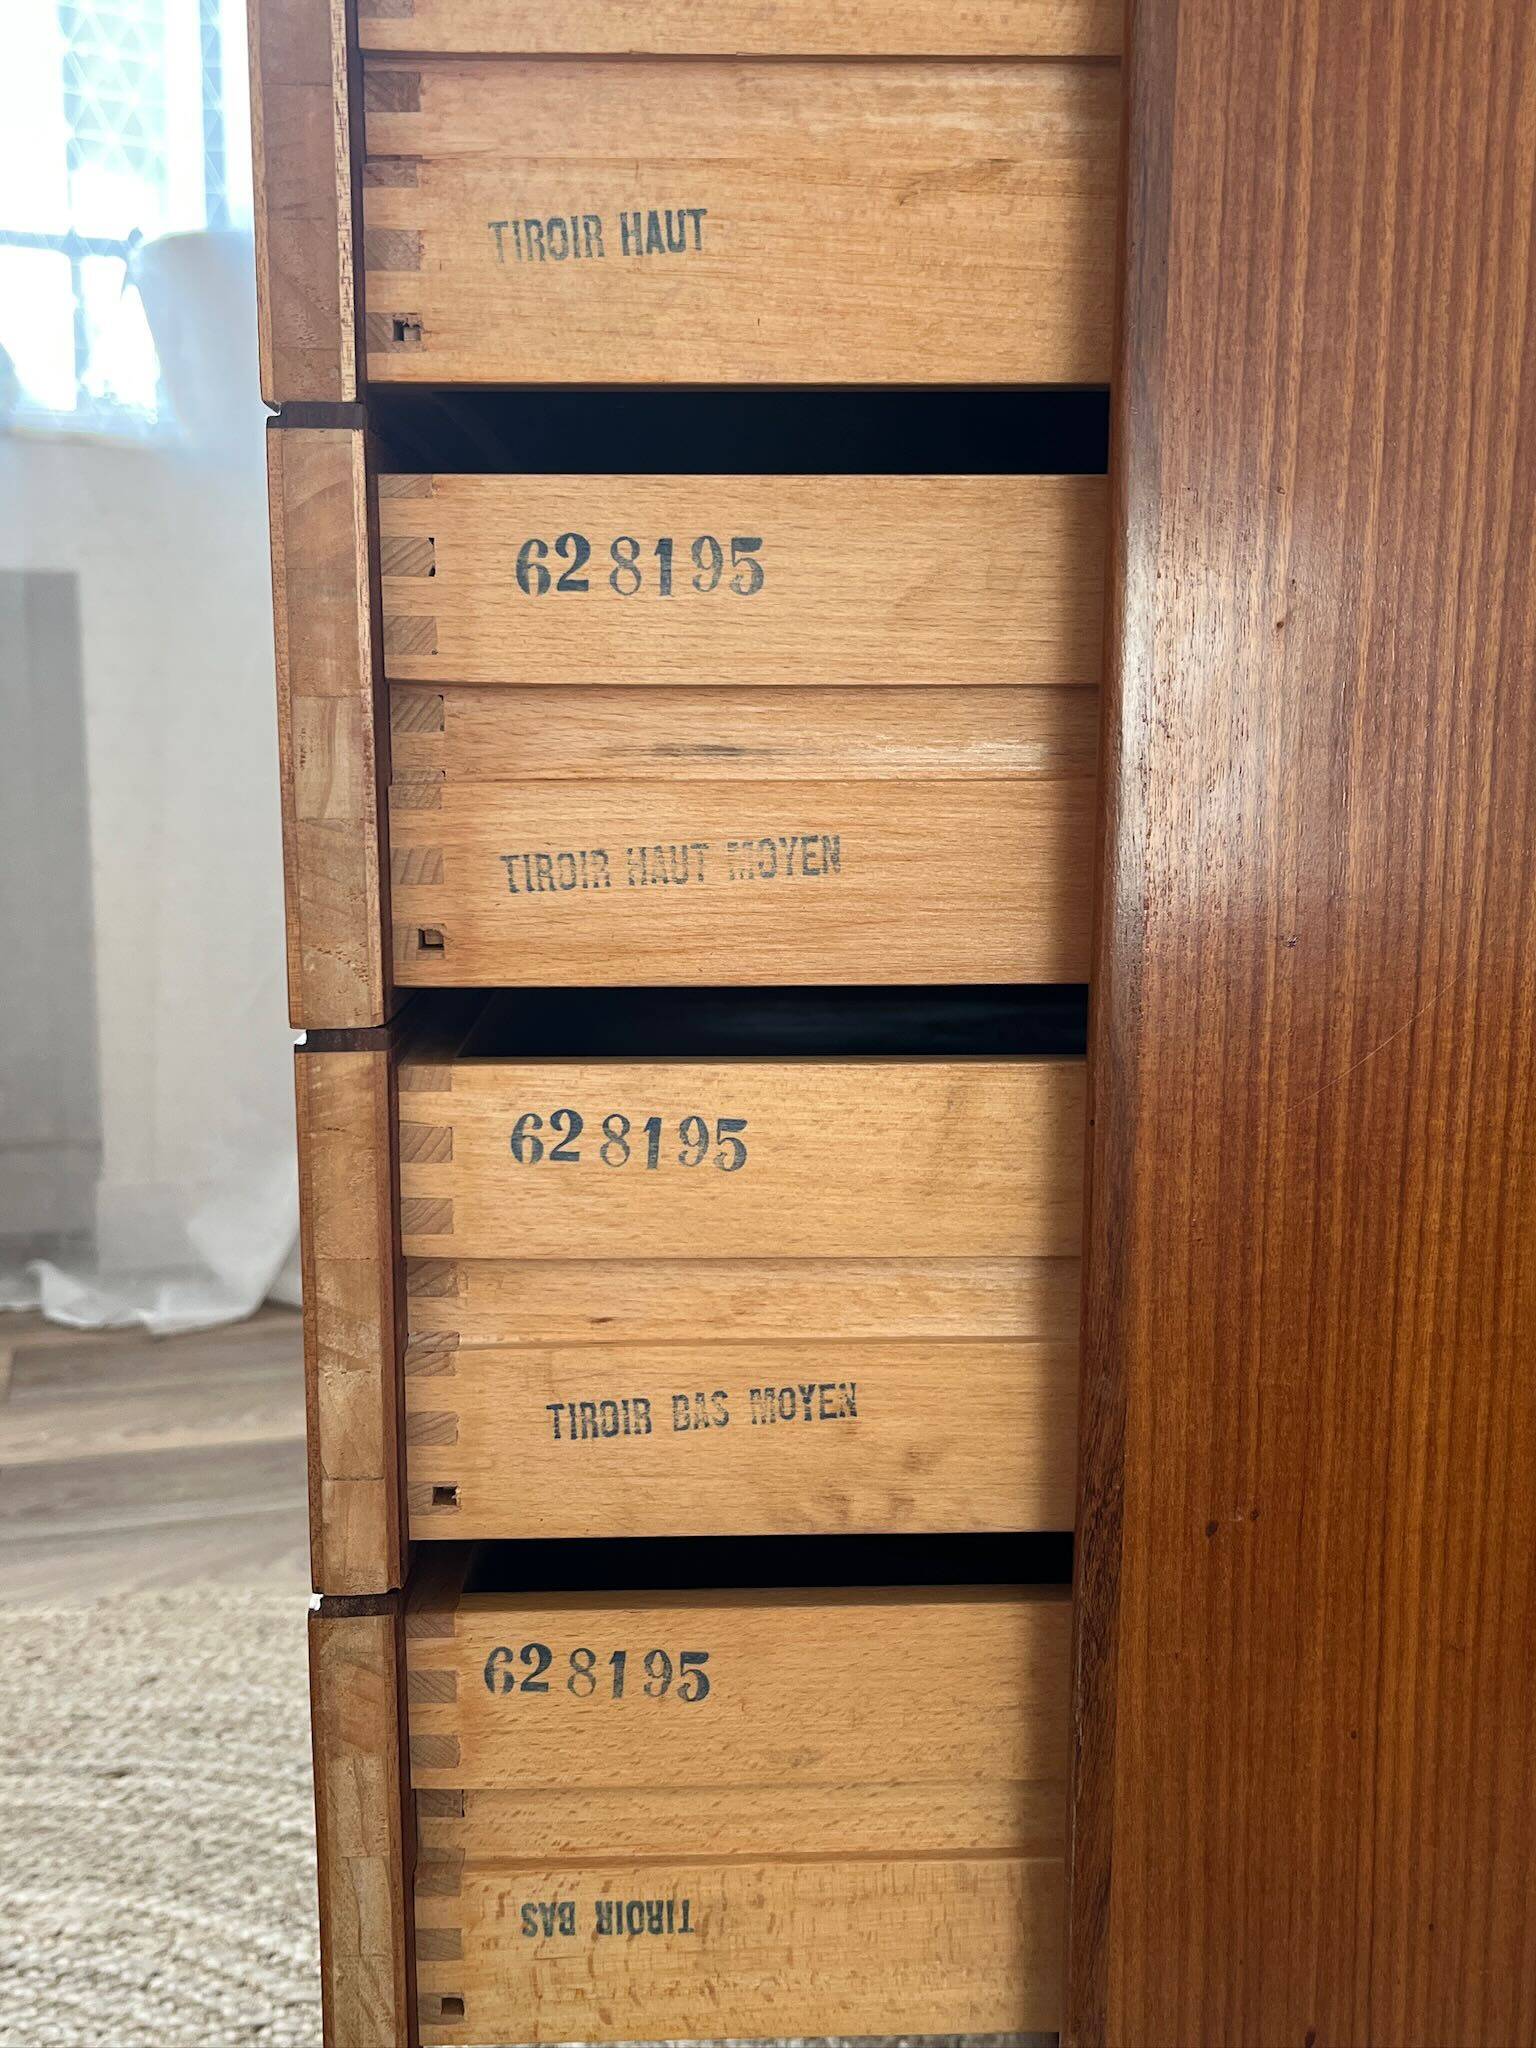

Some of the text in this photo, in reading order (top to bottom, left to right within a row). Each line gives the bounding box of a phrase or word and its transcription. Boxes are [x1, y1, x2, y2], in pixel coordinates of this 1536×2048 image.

[489, 208, 707, 263] TIROIR HAUT
[500, 849, 611, 894] TIROIR
[626, 843, 710, 886] HAUT
[546, 1383, 857, 1441] TIROIR BAS MOYEN
[520, 1901, 694, 1937] TIROIR BAS
